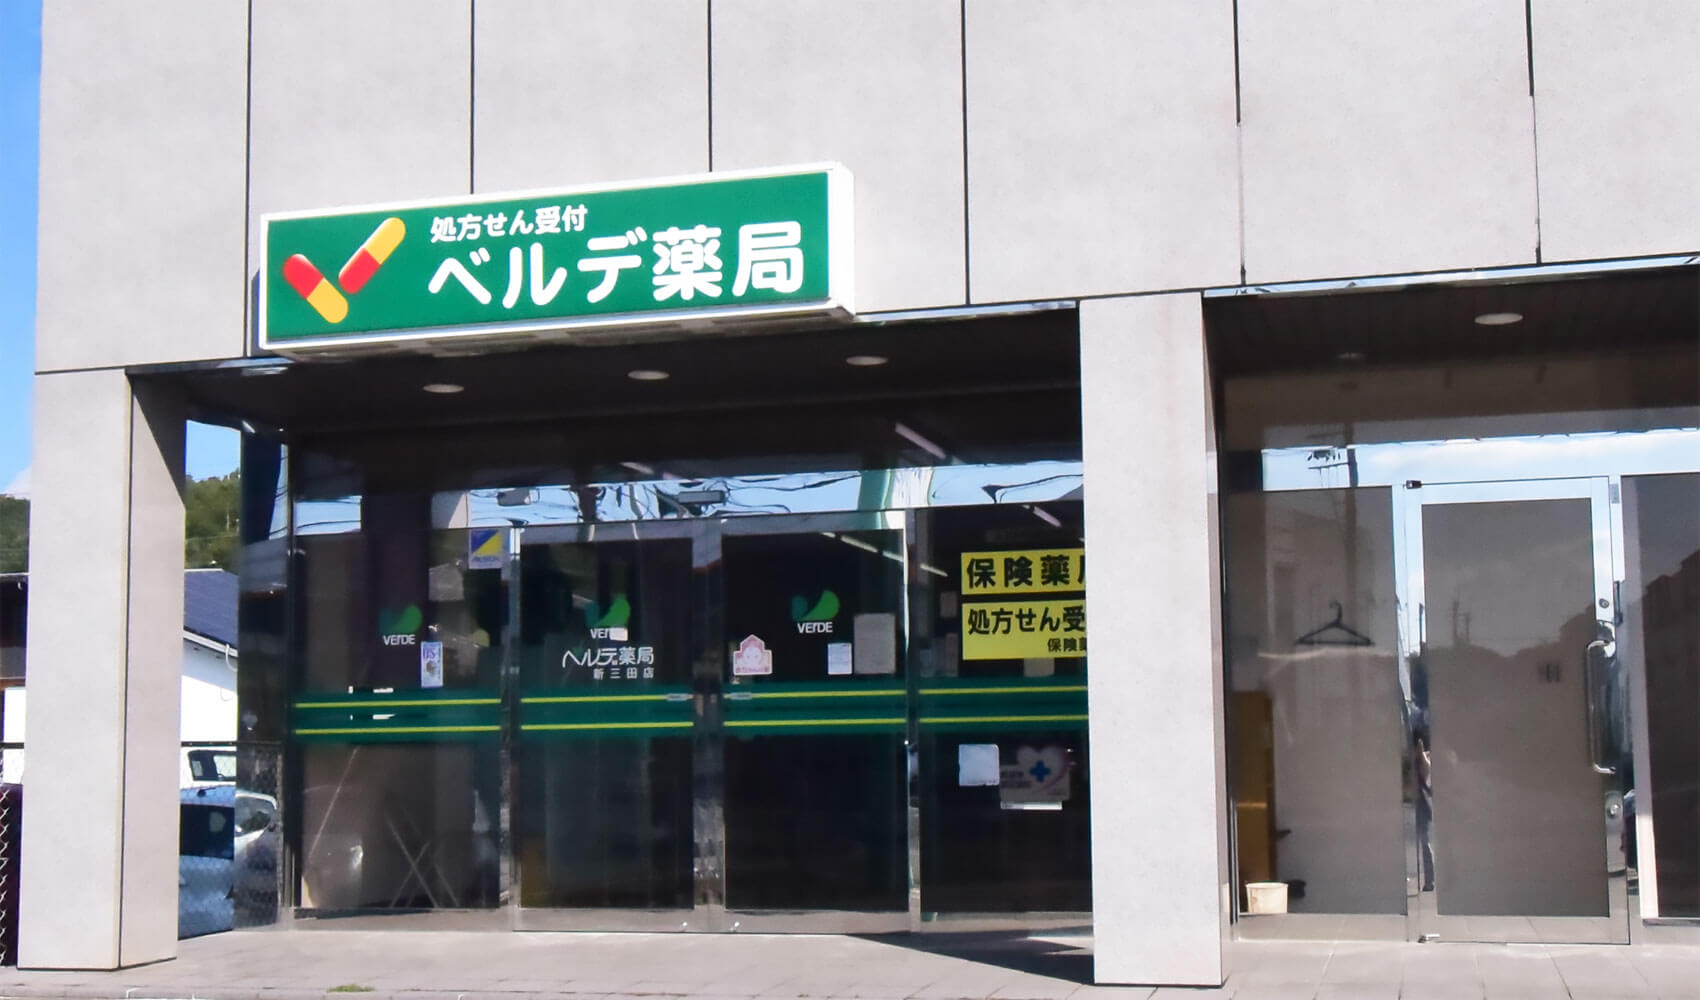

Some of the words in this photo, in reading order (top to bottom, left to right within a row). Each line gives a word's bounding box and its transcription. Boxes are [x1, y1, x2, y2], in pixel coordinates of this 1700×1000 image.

[430, 204, 588, 244] 処方せん受付
[428, 220, 804, 309] ベルデ薬局
